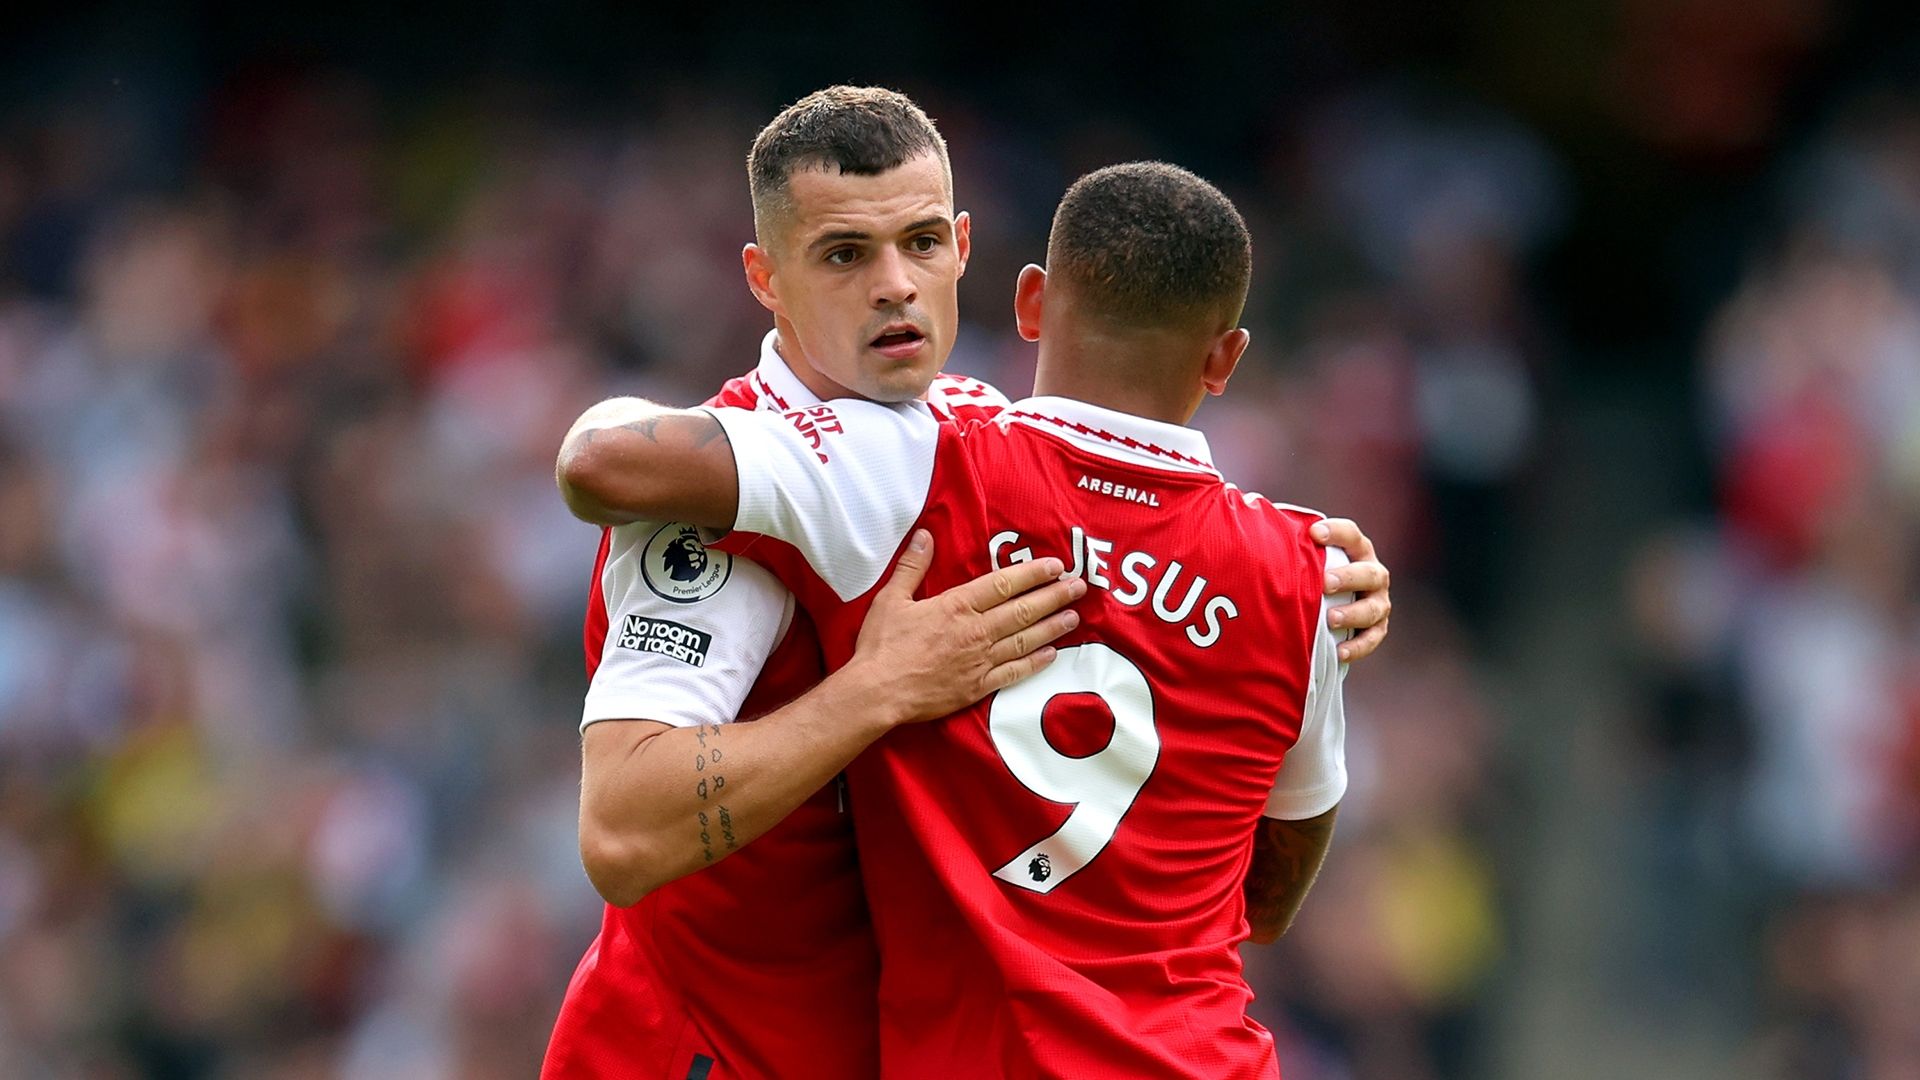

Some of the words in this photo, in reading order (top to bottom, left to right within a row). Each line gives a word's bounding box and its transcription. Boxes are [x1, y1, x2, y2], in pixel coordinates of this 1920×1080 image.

[807, 407, 844, 435] SIT
[1077, 475, 1159, 507] ARSENAL
[672, 585, 703, 595] Premier
[701, 563, 721, 588] League
[1058, 526, 1239, 648] JESUS
[622, 615, 649, 635] No
[649, 622, 701, 649] room
[644, 637, 704, 667] racism
[988, 643, 1161, 895] 9
